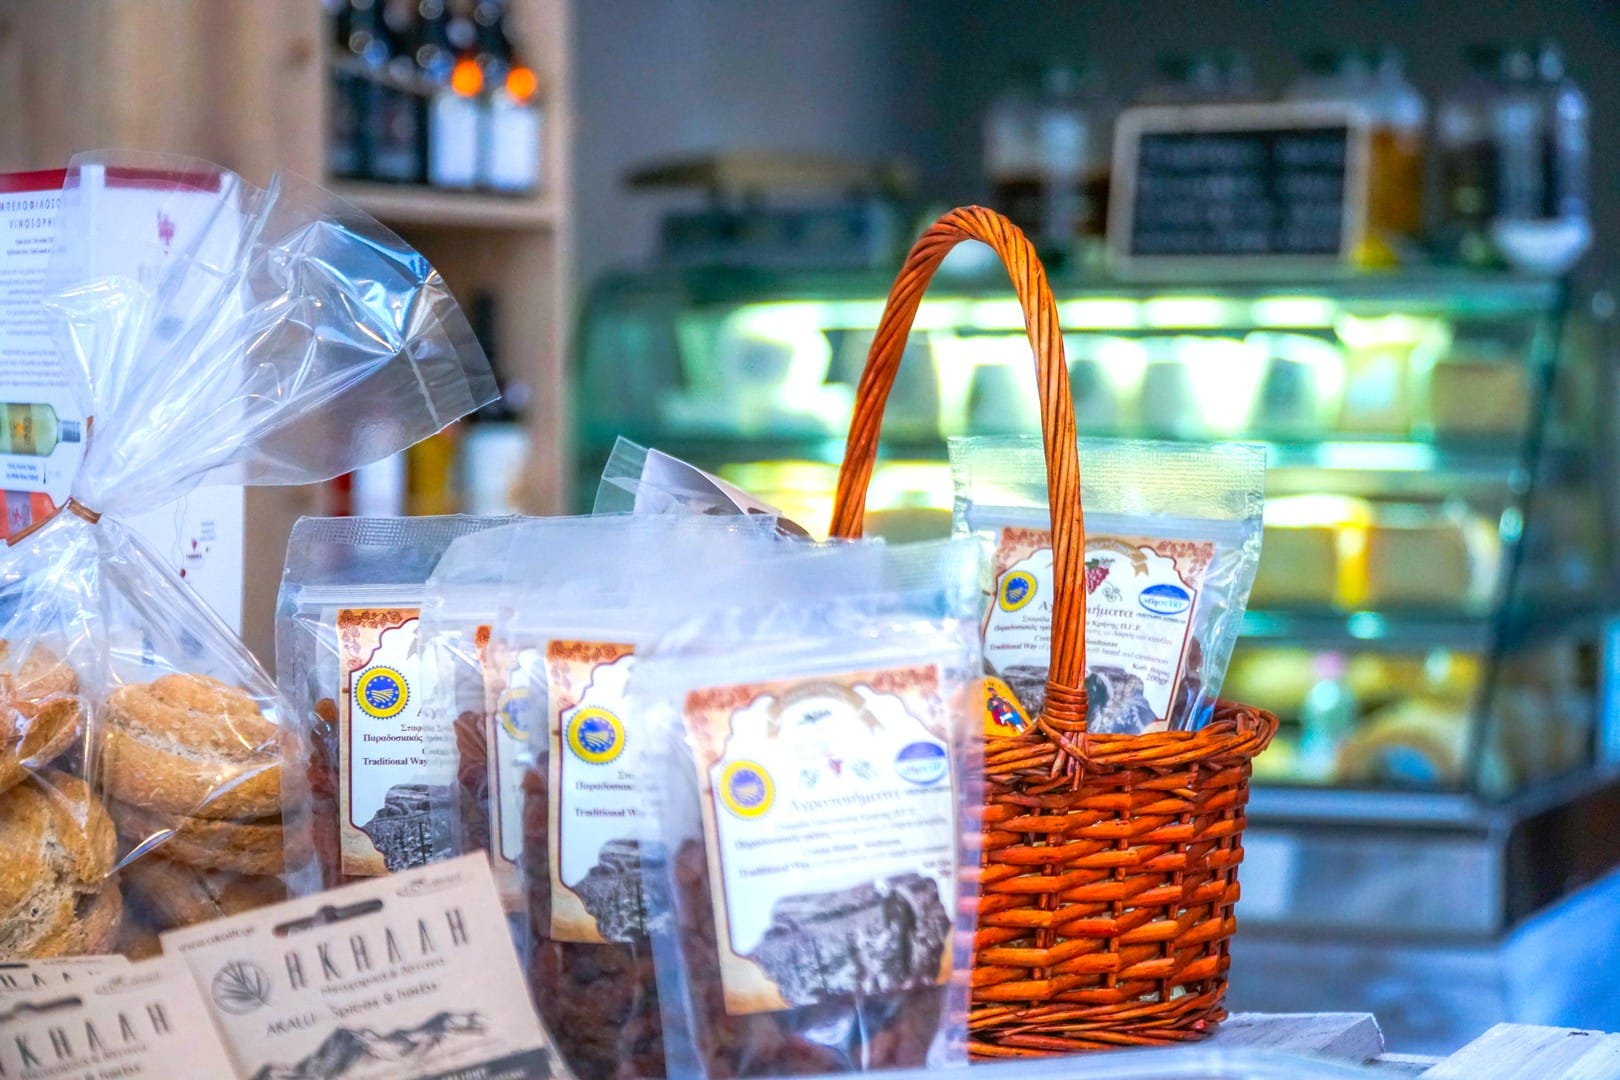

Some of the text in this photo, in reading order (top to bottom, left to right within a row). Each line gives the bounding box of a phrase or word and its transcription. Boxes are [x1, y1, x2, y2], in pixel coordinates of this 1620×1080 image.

[363, 757, 428, 768] Traditional Way
[575, 807, 626, 817] Traditional
